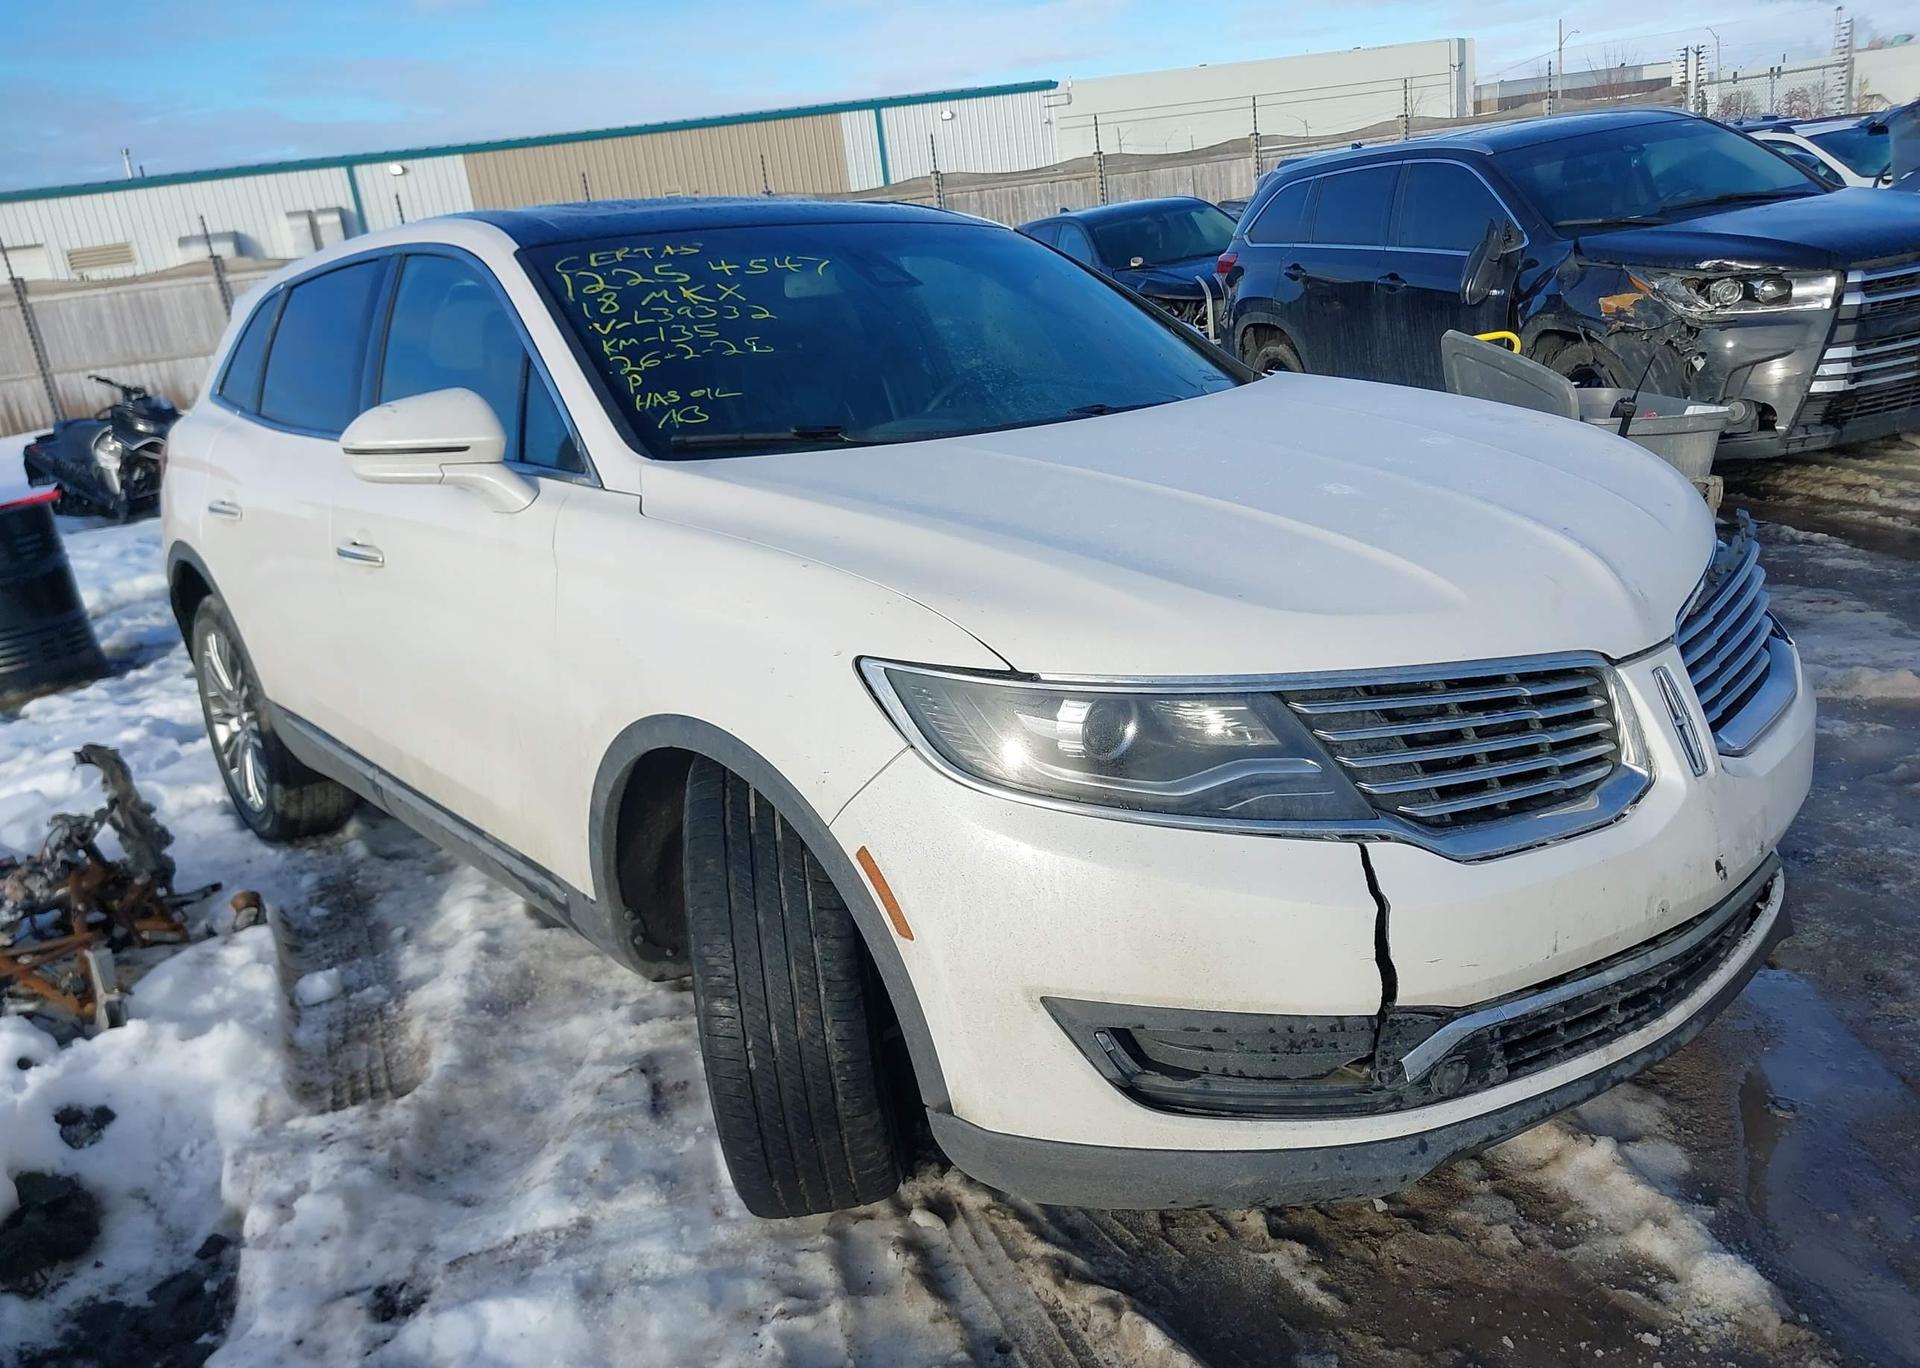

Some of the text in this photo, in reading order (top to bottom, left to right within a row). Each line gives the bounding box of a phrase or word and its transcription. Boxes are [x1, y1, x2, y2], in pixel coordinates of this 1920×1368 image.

[554, 242, 703, 273] CERTAS
[641, 283, 747, 306] MKX
[627, 373, 643, 395] P
[635, 387, 744, 412] HAS OIL
